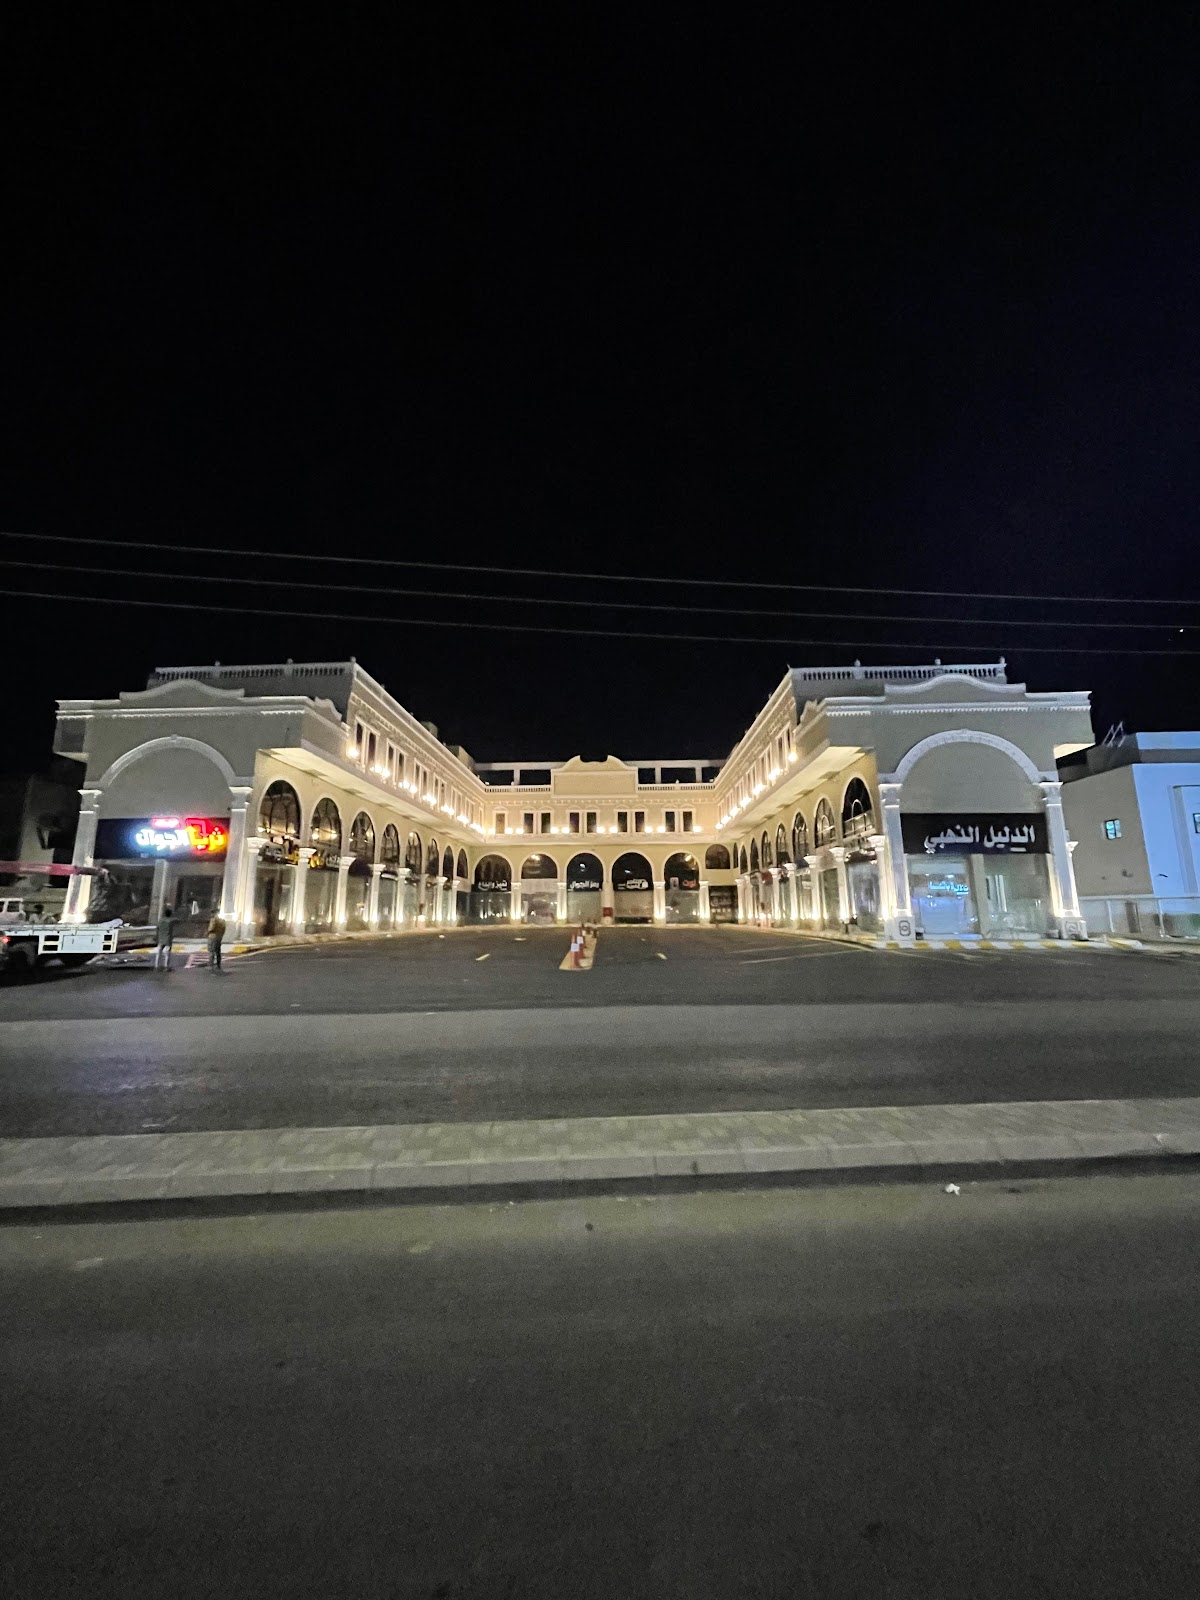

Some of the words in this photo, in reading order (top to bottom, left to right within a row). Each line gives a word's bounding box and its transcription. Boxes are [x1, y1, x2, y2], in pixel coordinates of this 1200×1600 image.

[136, 829, 190, 851] الجوال
[924, 825, 979, 854] الذهبي
[984, 825, 1035, 851] الدليل
